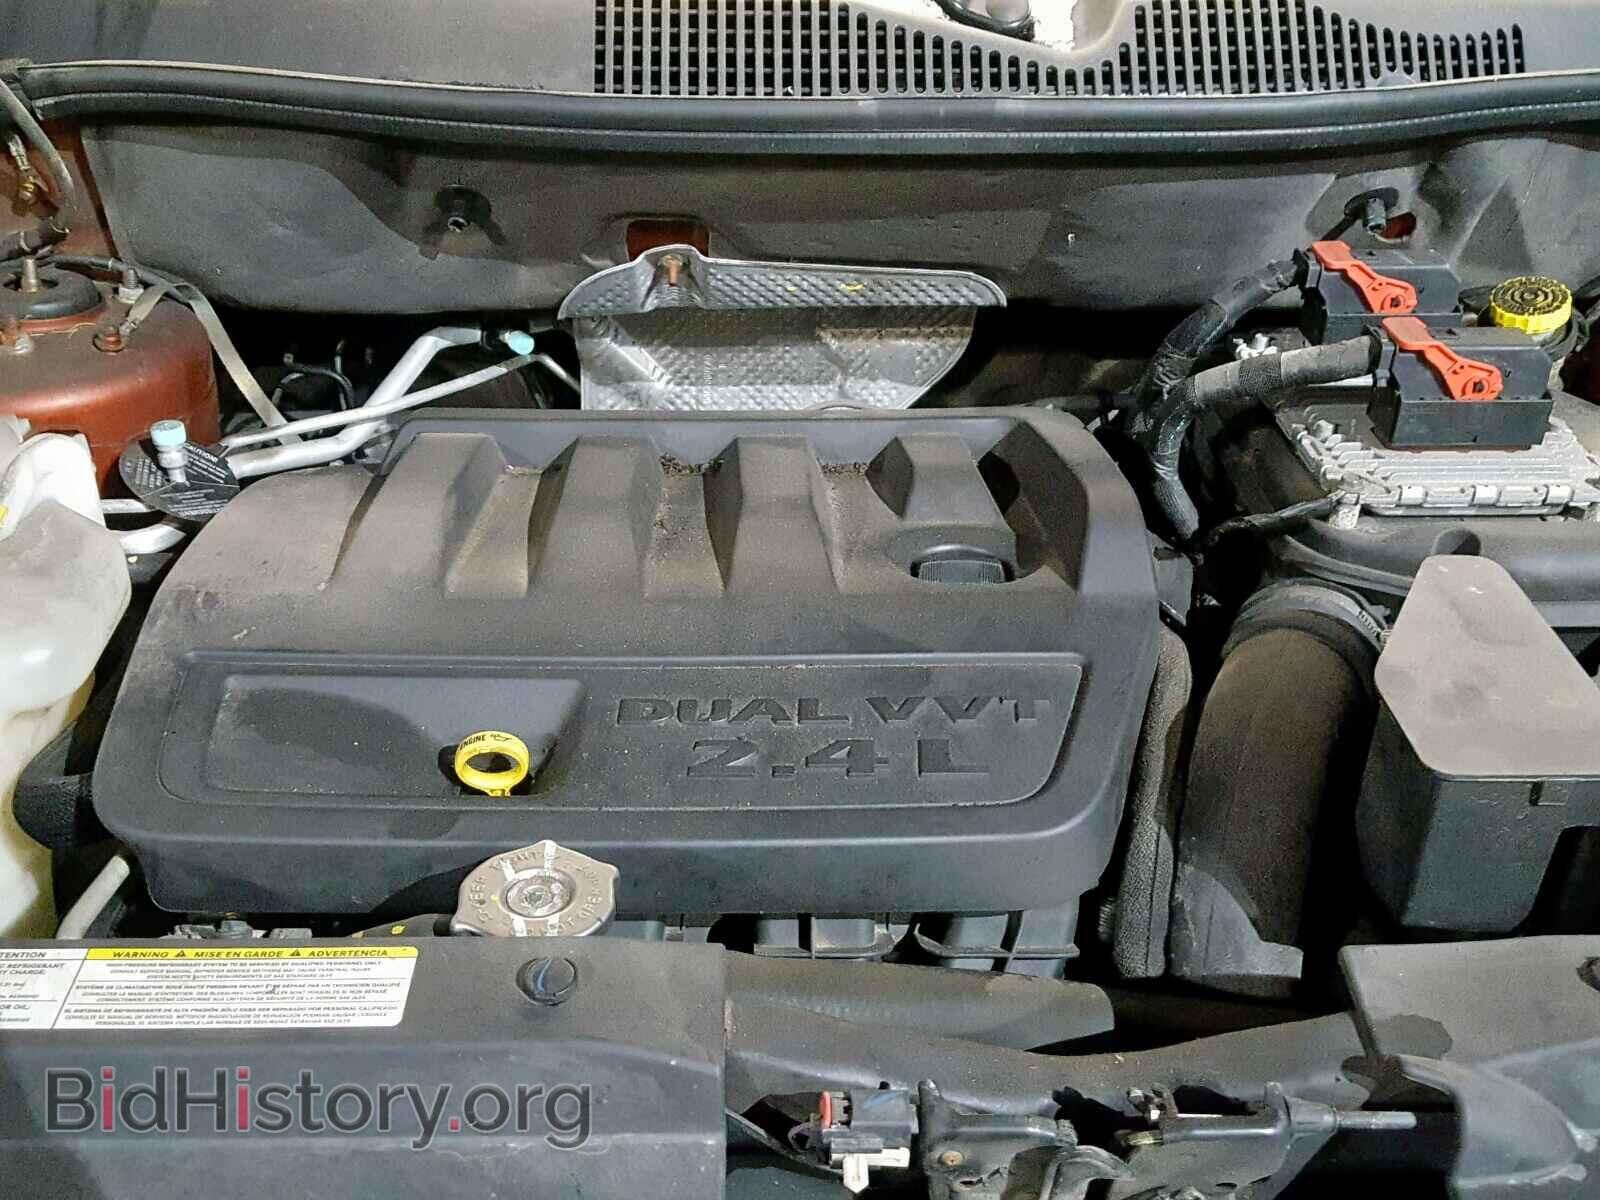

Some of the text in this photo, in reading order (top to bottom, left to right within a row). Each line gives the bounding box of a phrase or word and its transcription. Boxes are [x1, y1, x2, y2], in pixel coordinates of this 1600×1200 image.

[617, 695, 1051, 726] DUAL VVT
[112, 949, 388, 958] WARNING MISE EN GARDE ADVERTENCIA
